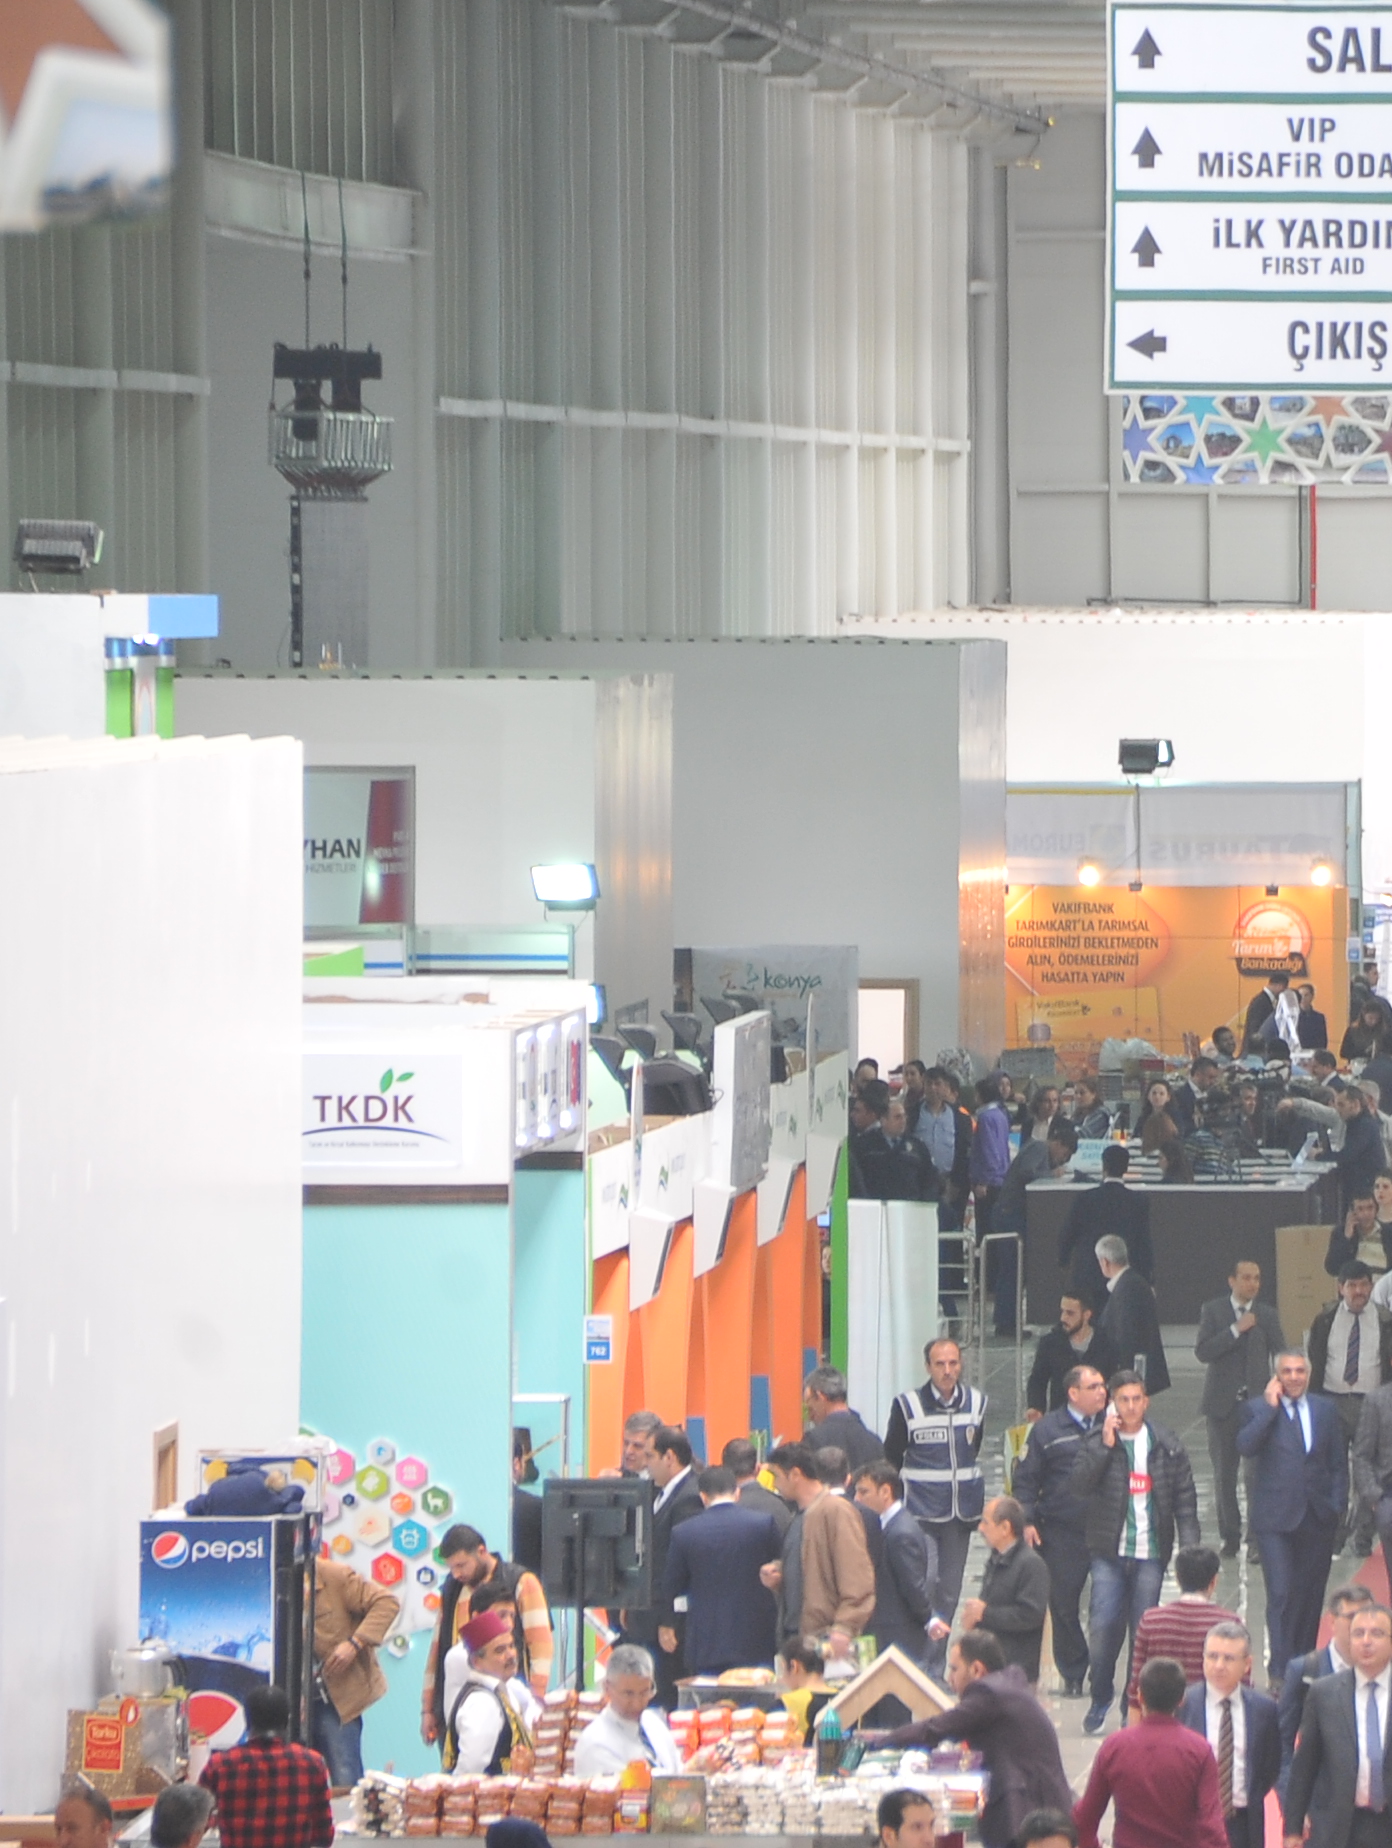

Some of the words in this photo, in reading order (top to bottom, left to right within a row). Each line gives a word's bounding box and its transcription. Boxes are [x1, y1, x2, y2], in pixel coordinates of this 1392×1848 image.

[1287, 117, 1337, 143] VIP
[1262, 257, 1322, 276] FIRST
[1329, 257, 1365, 276] AID
[1287, 320, 1388, 373] ÇIKIŞ
[1052, 902, 1114, 914] VAKIFBANK
[1097, 919, 1150, 932] TARIMSAL
[1084, 936, 1159, 949] BEKLETMEDEN
[763, 967, 824, 999] konya
[1042, 971, 1089, 983] HASATTA
[1092, 971, 1125, 983] YAPIN
[312, 1094, 415, 1123] TKDK
[590, 1345, 607, 1357] 762
[191, 1536, 265, 1563] pepsi
